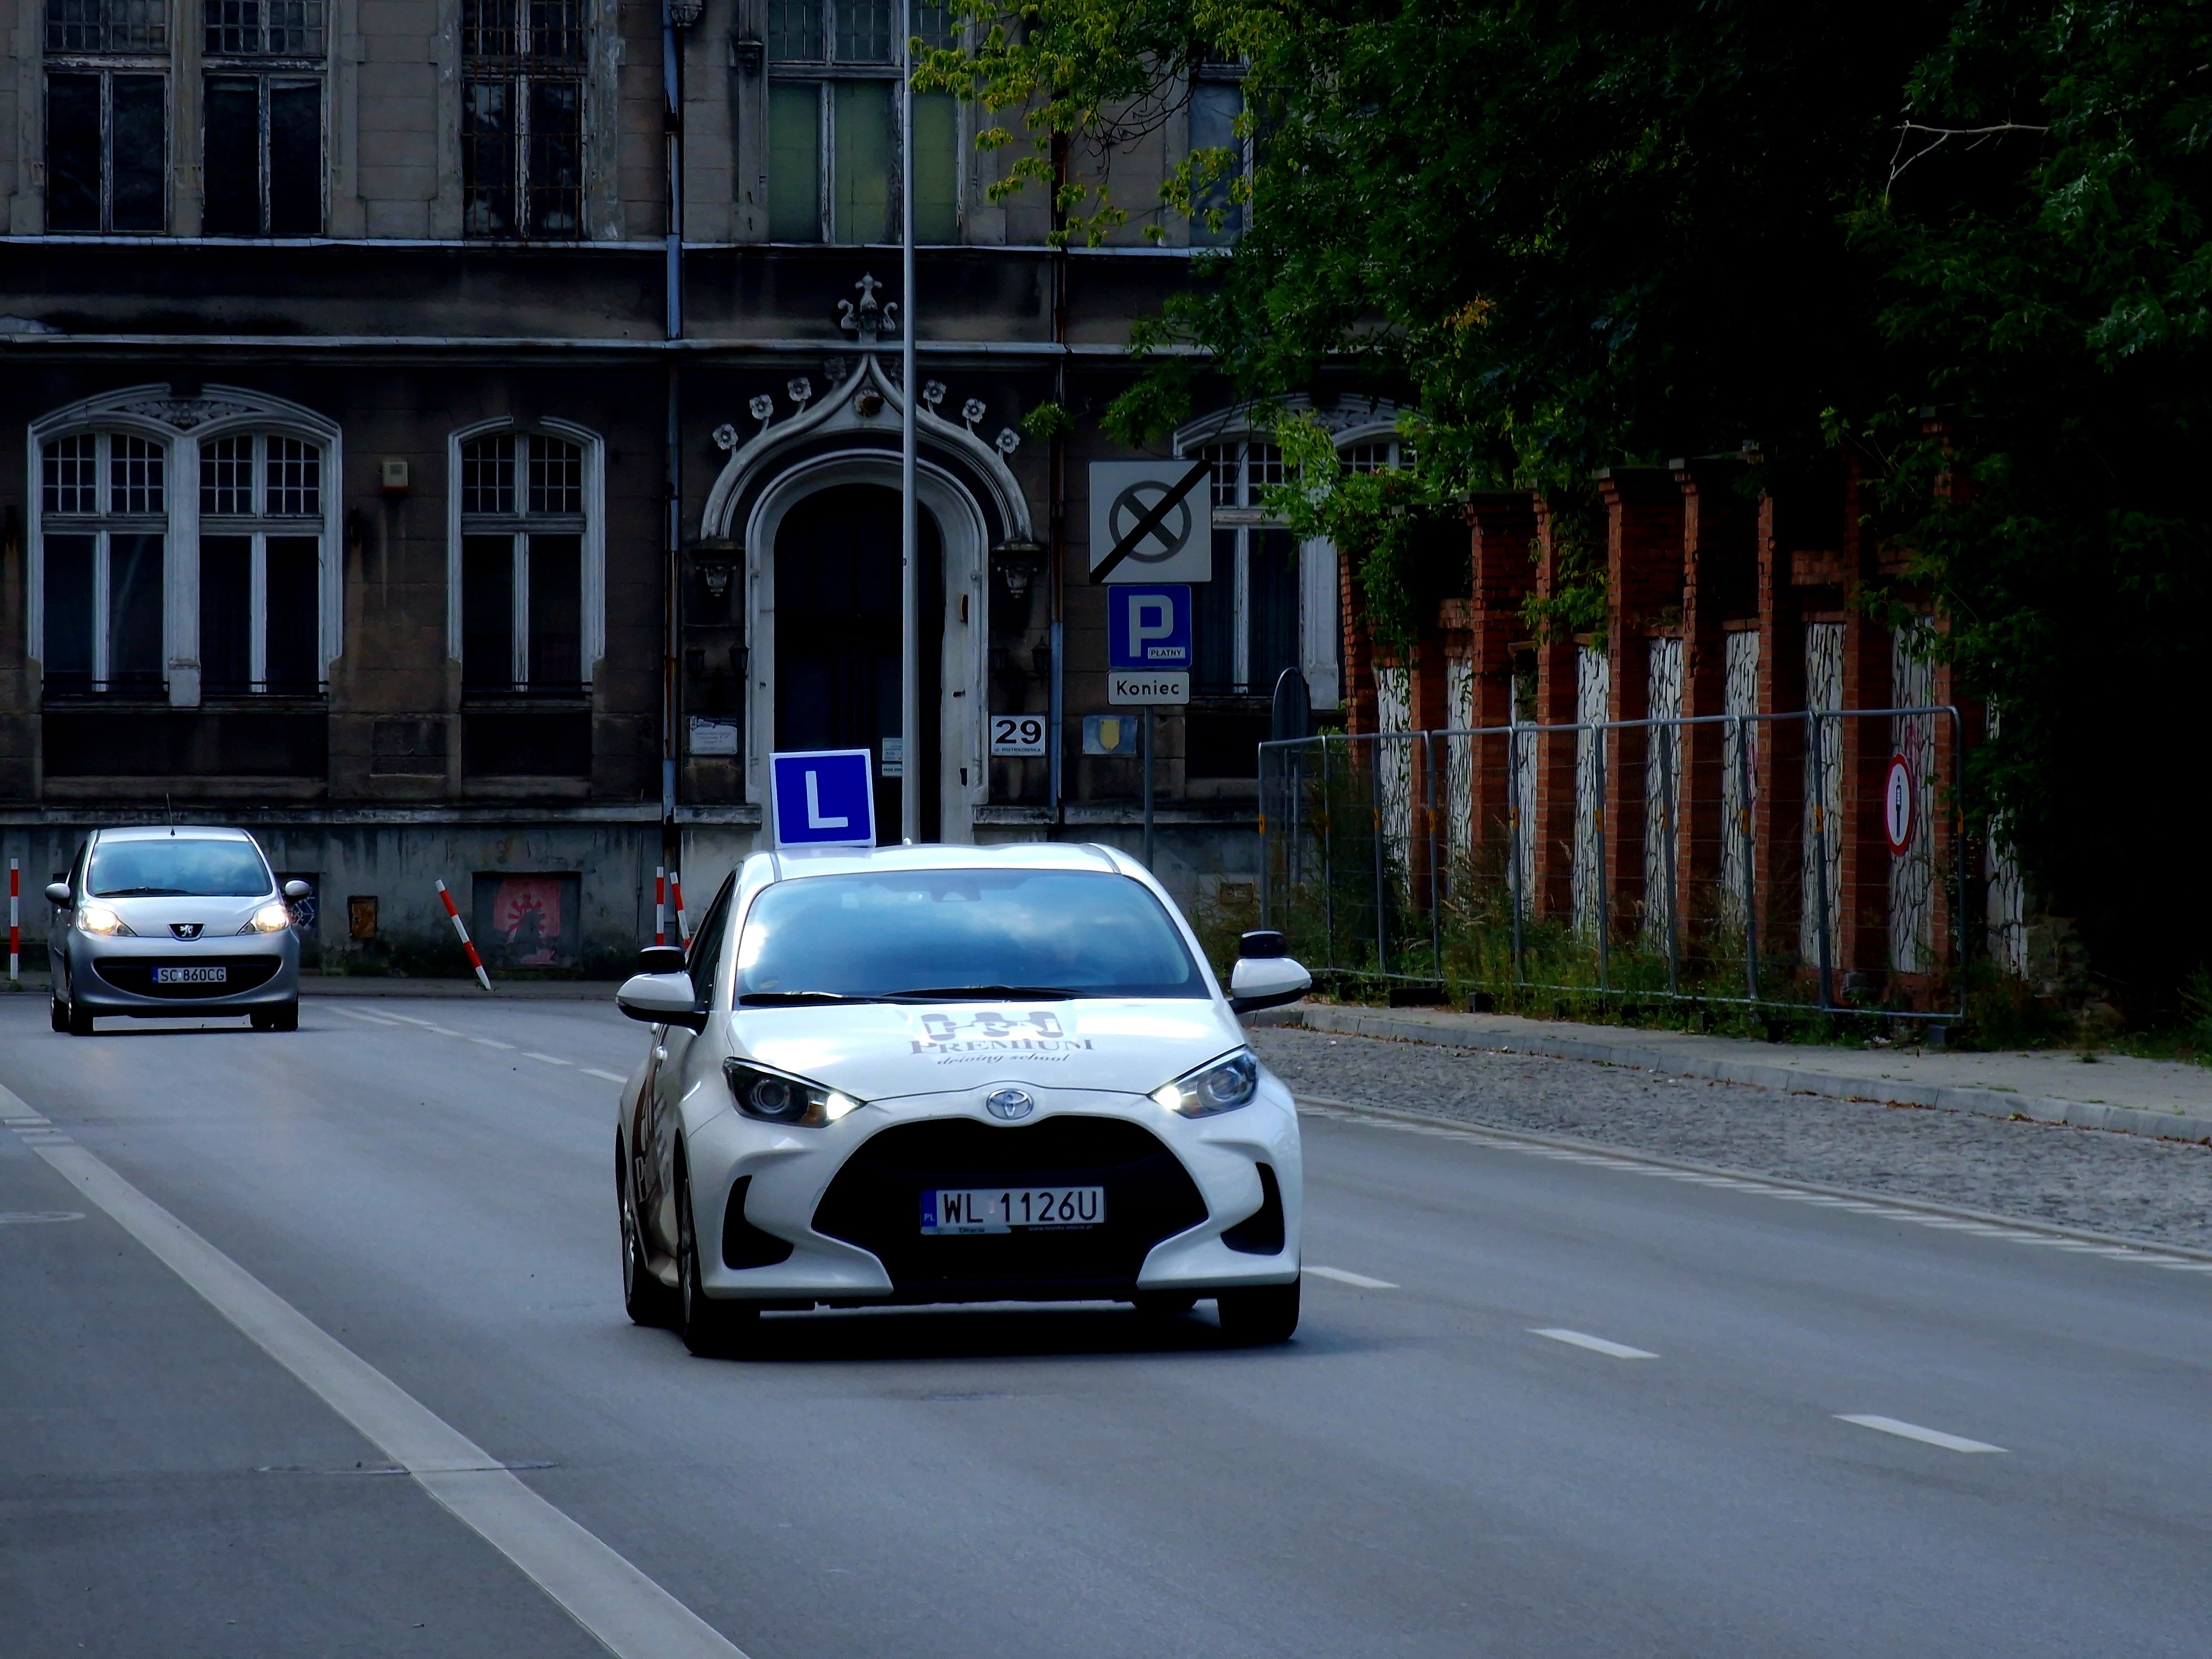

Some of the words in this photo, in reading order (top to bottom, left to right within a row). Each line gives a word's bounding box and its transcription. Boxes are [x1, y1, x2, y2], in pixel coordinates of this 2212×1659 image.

[1129, 595, 1173, 657] P
[1117, 680, 1180, 695] Koniec
[995, 720, 1041, 744] 29
[806, 771, 848, 828] L
[161, 969, 178, 982] SC
[184, 969, 225, 981] 860CG
[909, 1039, 1095, 1053] PREMIUM
[937, 1055, 1004, 1065] driving
[1010, 1053, 1070, 1062] school
[944, 1193, 983, 1223] WL
[1000, 1191, 1097, 1222] 1126U
